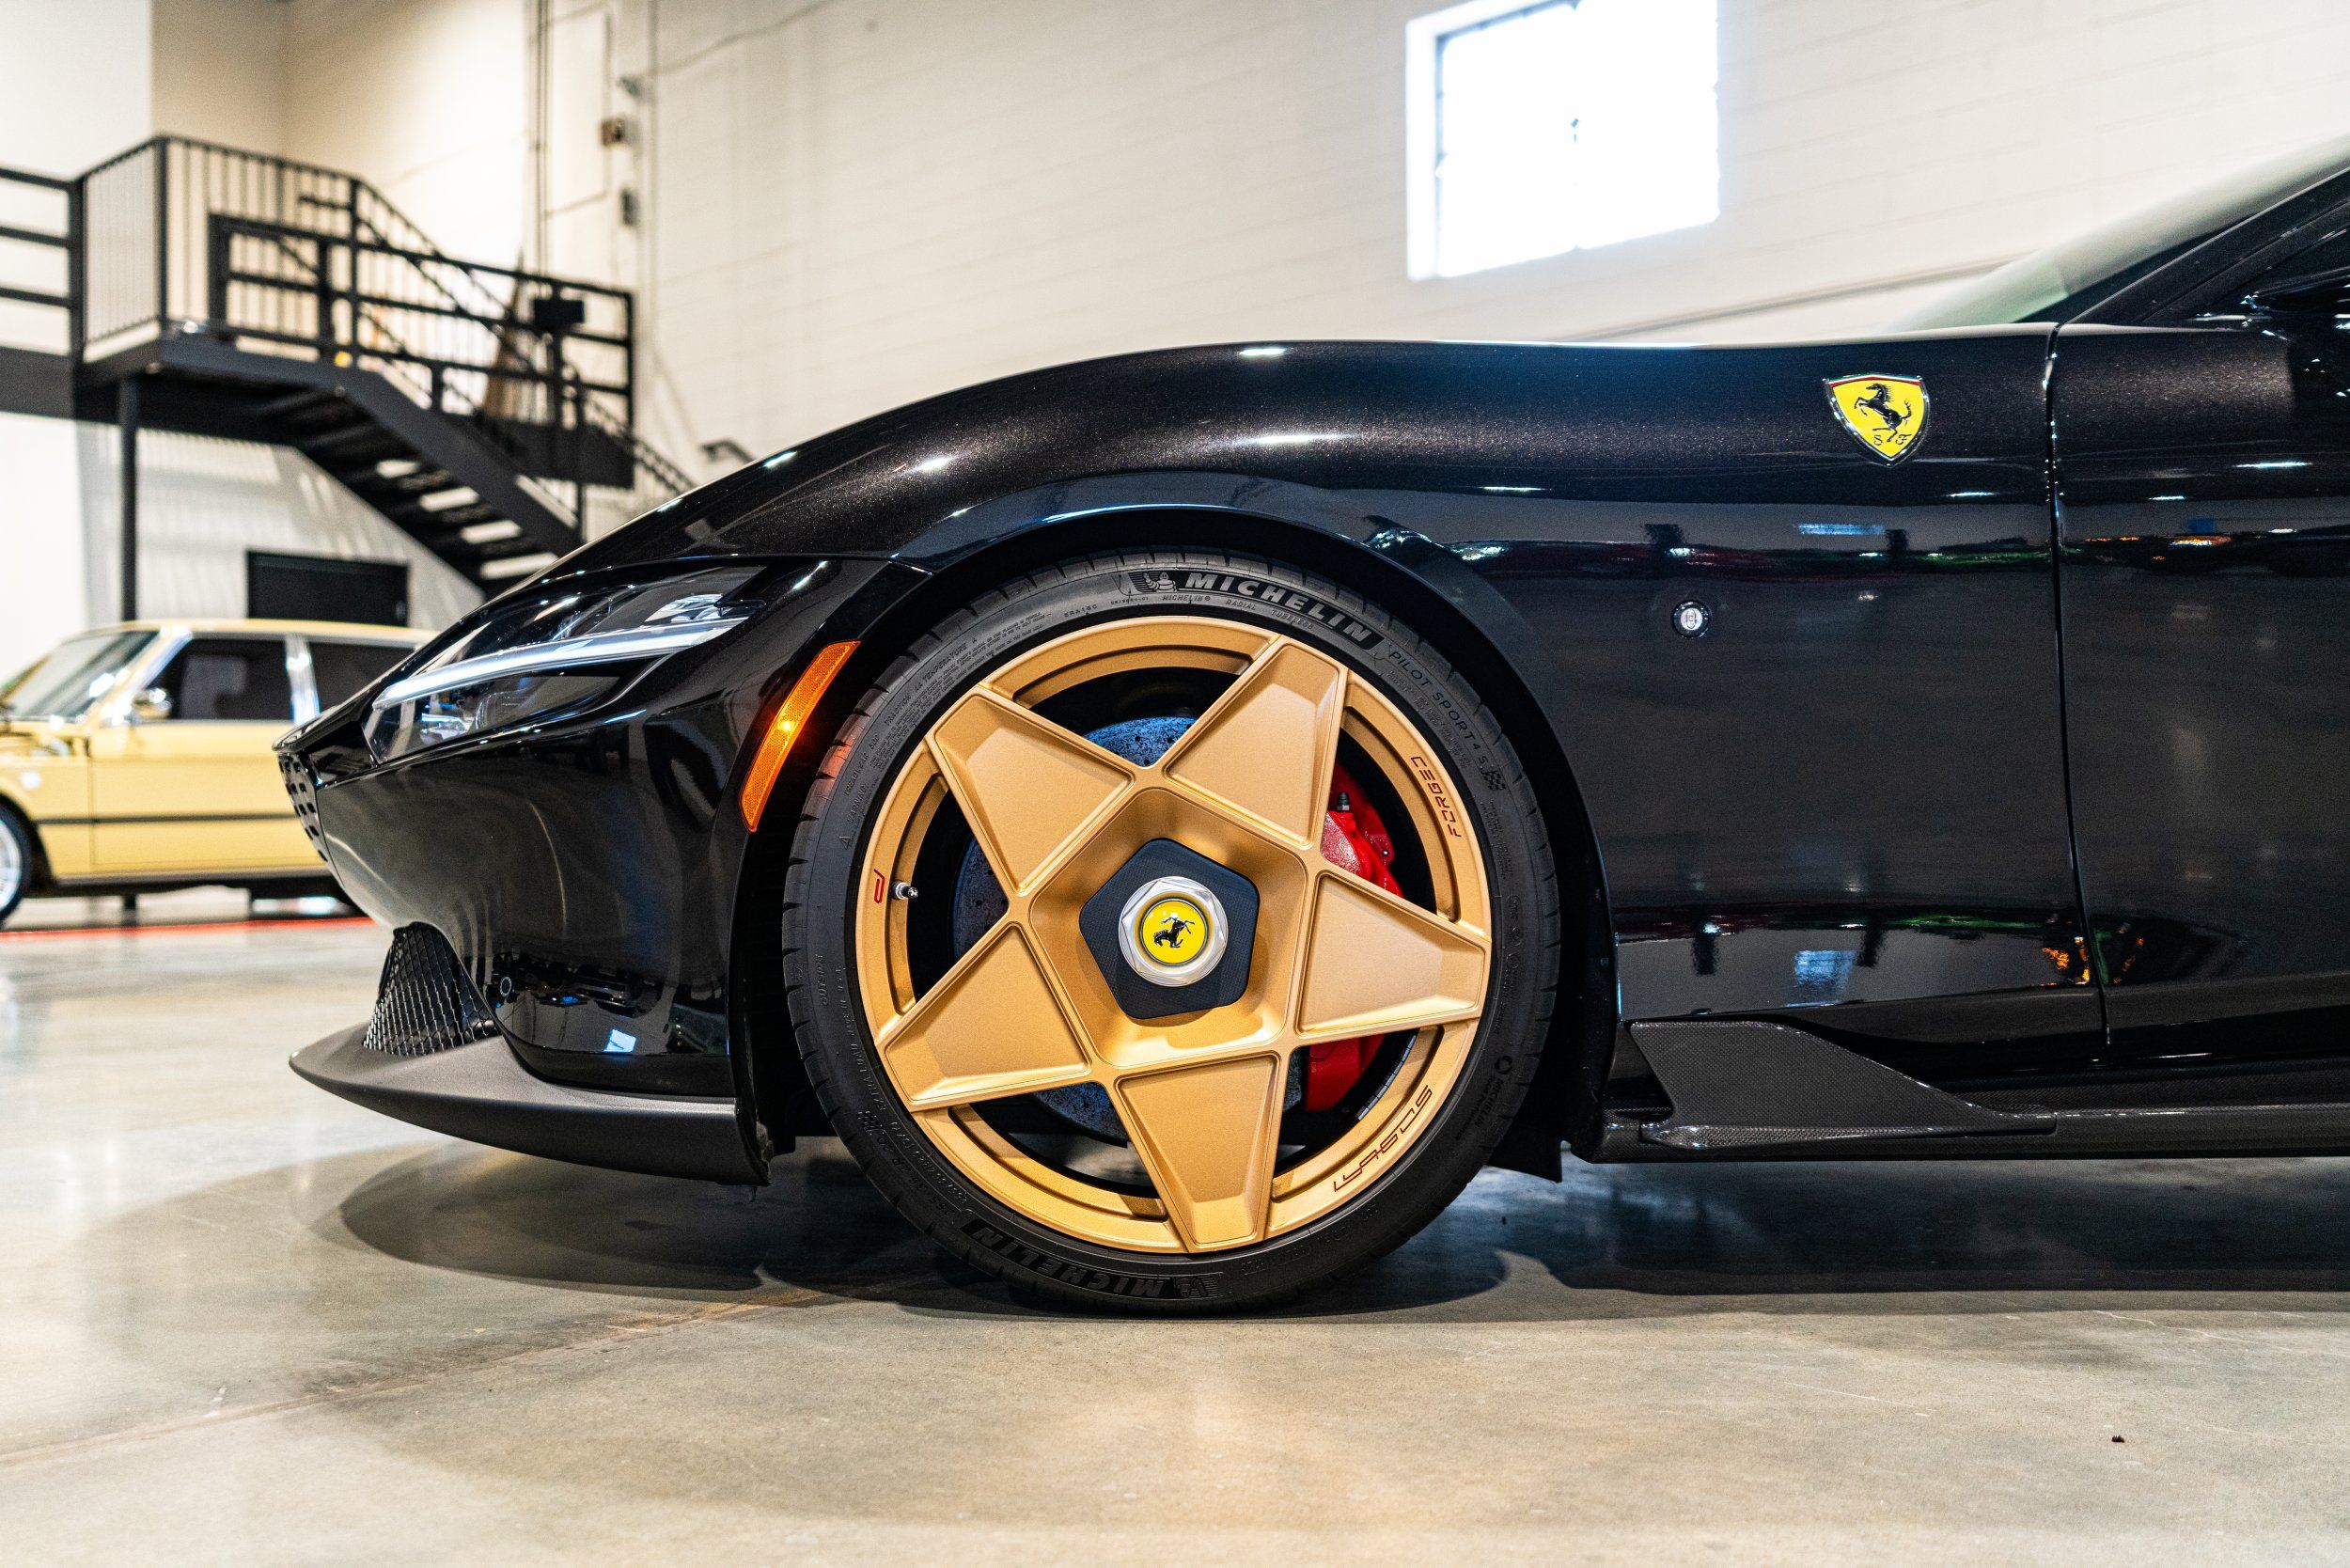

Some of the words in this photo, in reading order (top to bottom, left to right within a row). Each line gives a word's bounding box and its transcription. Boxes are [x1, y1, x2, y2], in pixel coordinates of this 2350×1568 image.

[1184, 572, 1372, 642] MICHELIN
[1225, 598, 1257, 611] RADIAL
[1271, 608, 1315, 632] TUBELESS
[1388, 650, 1431, 688] PILOT
[1432, 691, 1476, 742] SPORT
[1471, 741, 1482, 752] 4
[1477, 754, 1490, 767] S
[1411, 755, 1463, 838] FORGED
[1473, 1077, 1506, 1129] MICHELIN
[970, 1221, 1164, 1298] MICHELIN
